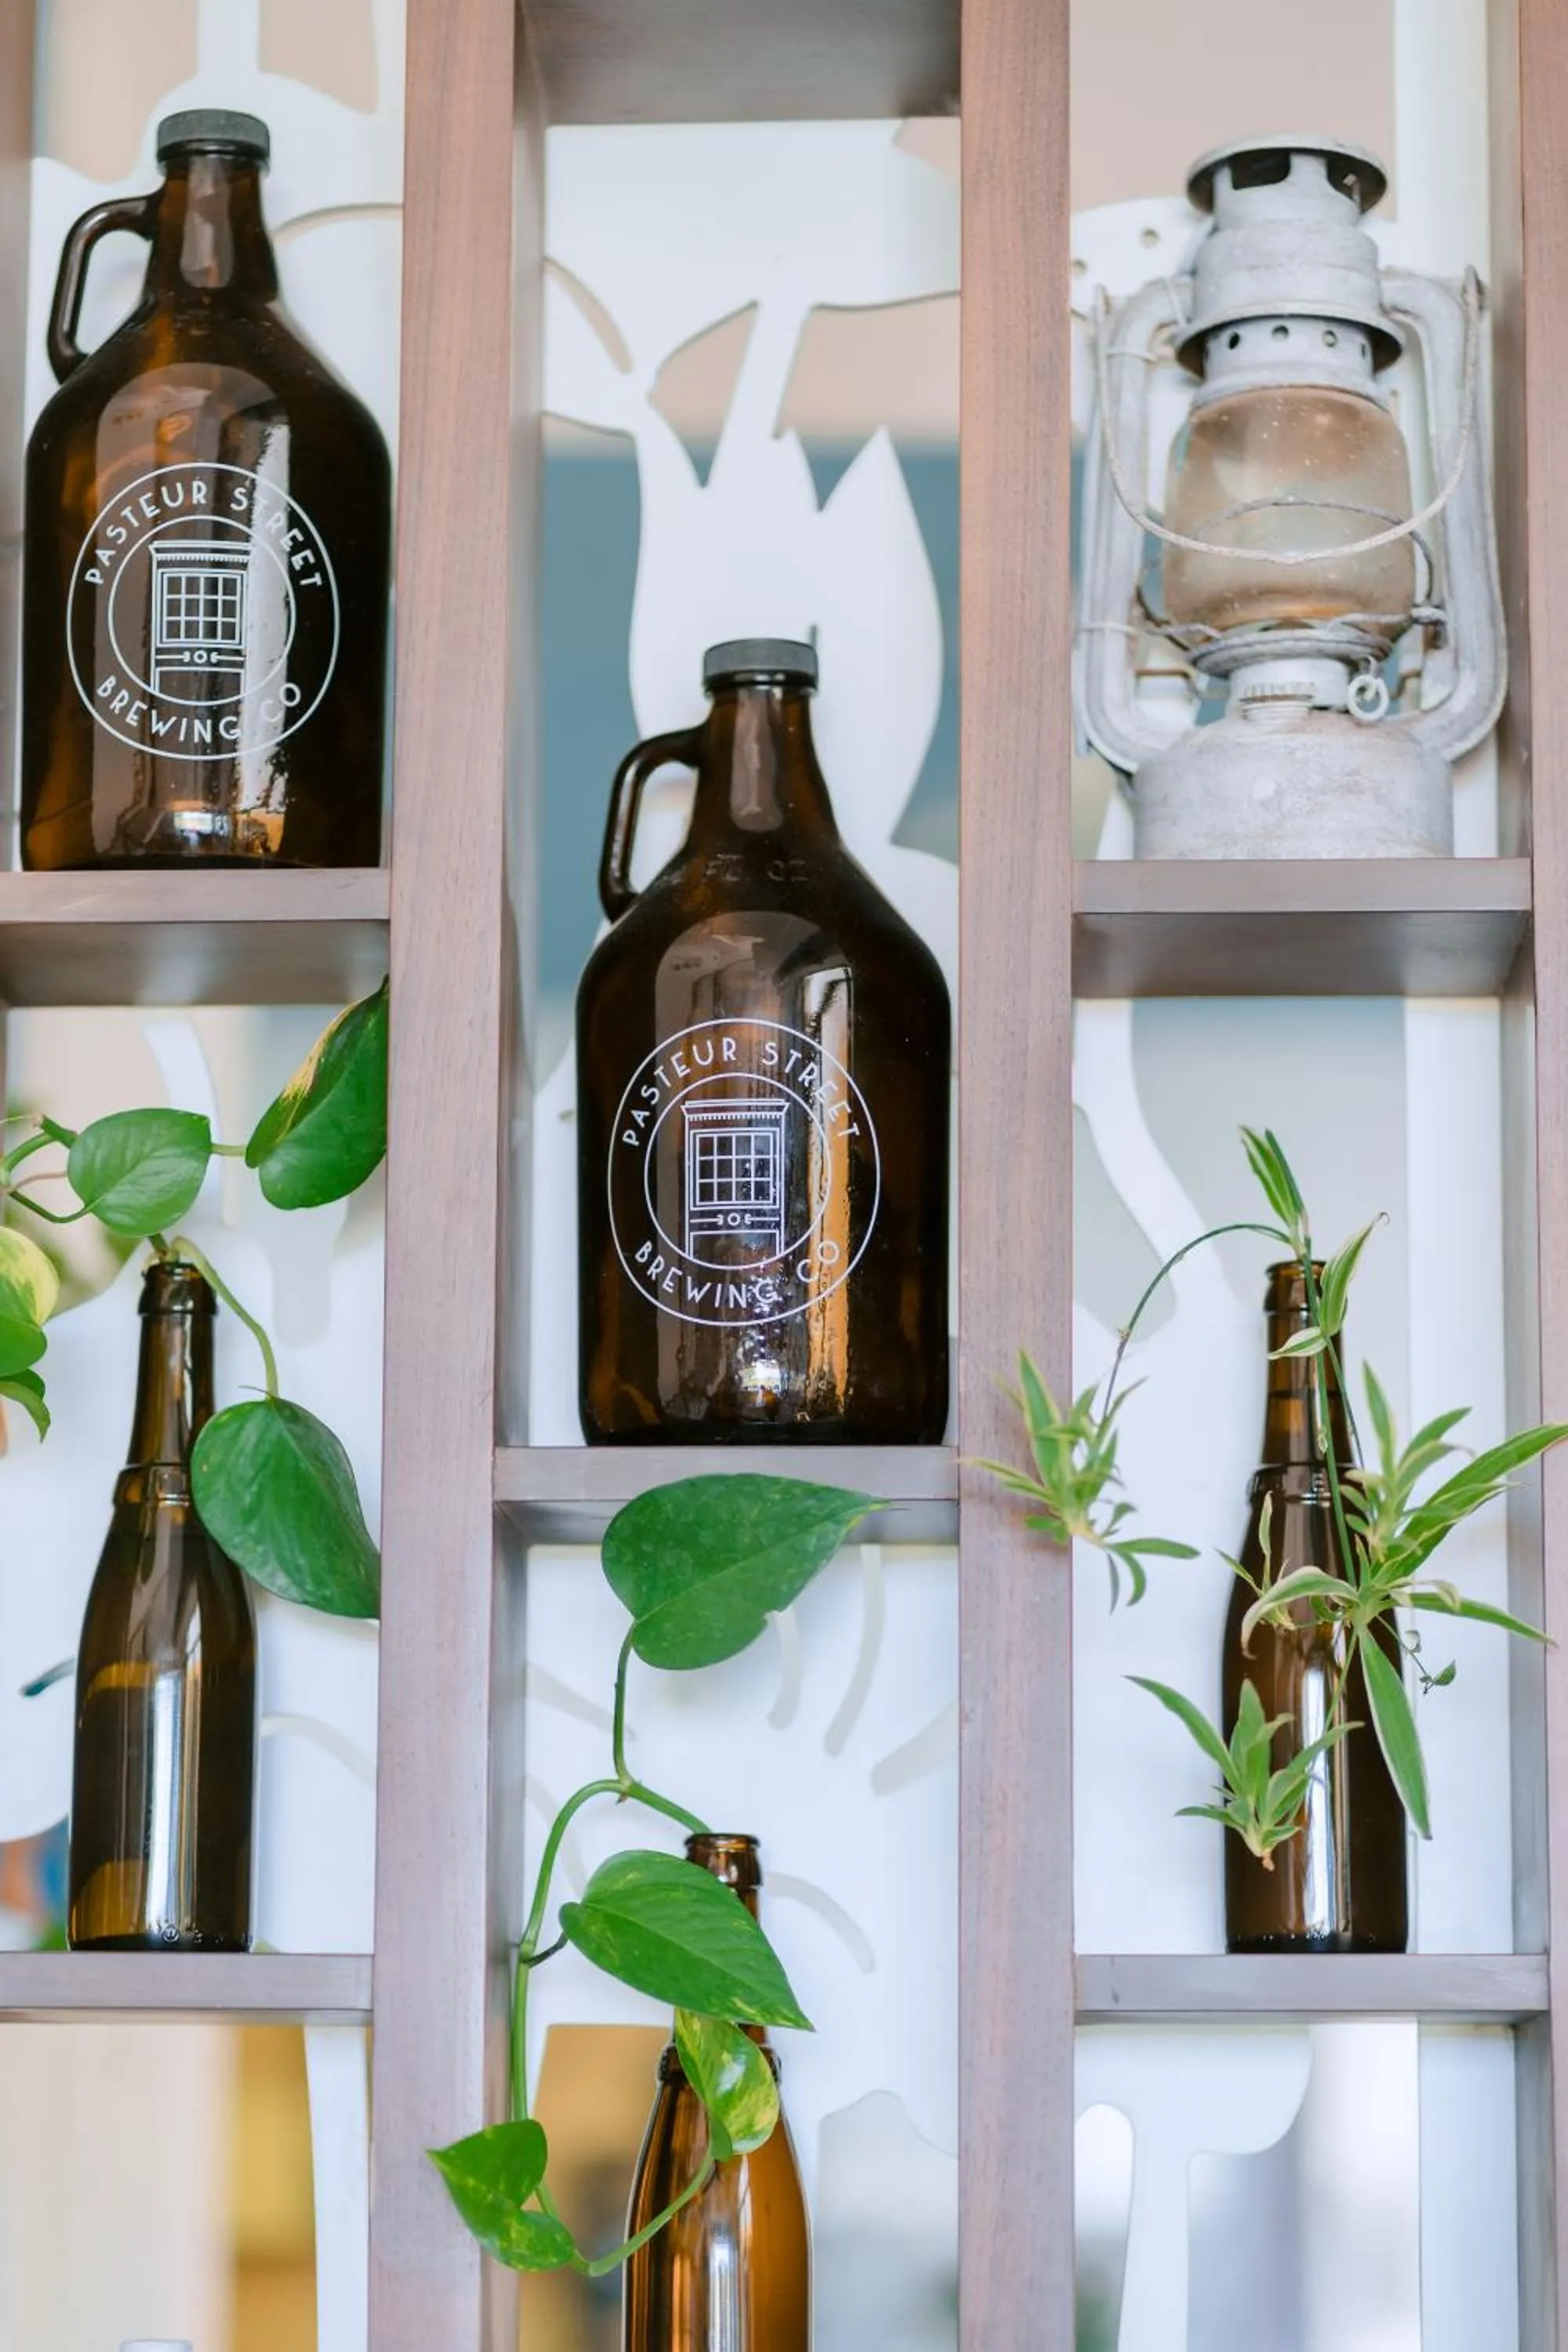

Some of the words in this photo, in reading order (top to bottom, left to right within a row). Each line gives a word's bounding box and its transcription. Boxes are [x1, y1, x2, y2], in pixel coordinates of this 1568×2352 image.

[85, 481, 207, 585] PASTEUR
[230, 487, 322, 586] STREET
[96, 675, 240, 743] BREWING
[261, 682, 301, 723] CO
[622, 1037, 737, 1147] PASTEUR
[763, 1042, 859, 1138] STREET
[635, 1240, 779, 1308] BREWING
[797, 1240, 840, 1283] CO
